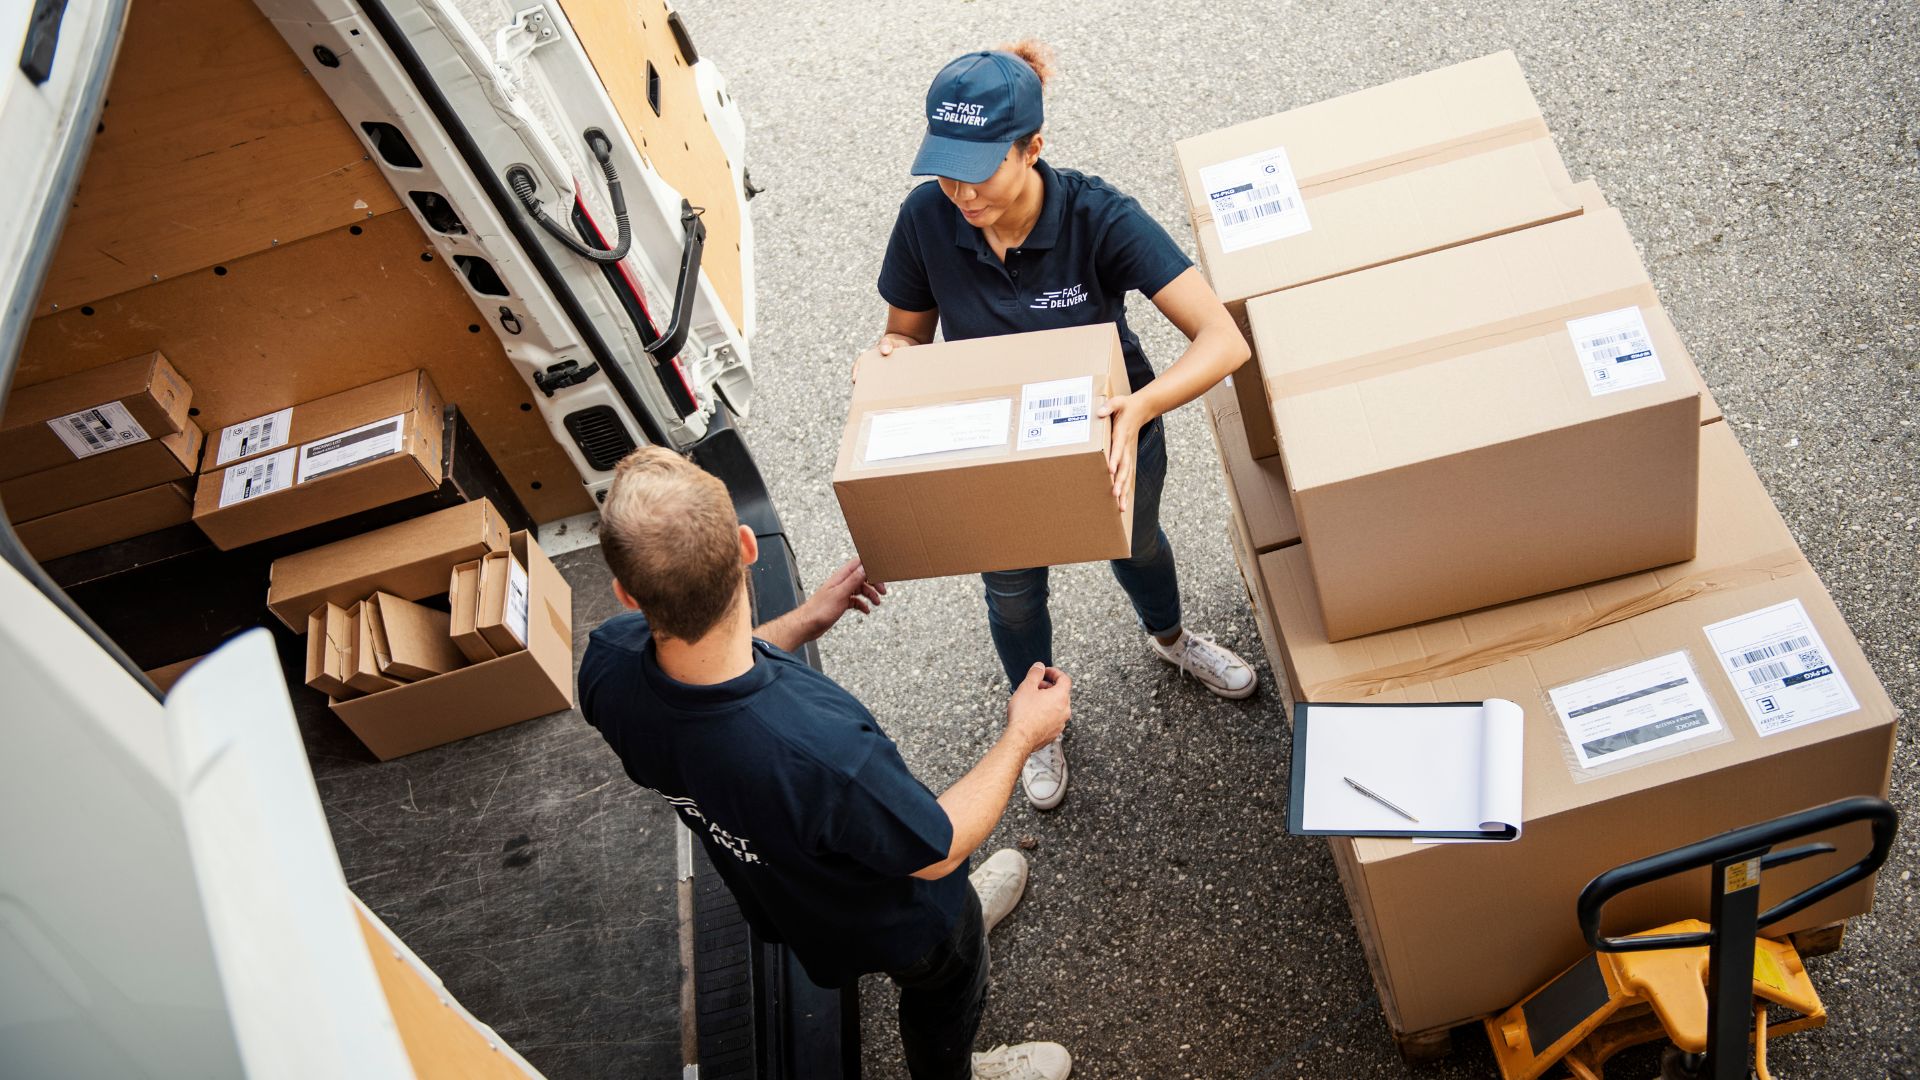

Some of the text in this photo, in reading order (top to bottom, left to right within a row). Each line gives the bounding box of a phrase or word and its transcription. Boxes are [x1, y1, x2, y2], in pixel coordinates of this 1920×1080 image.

[957, 102, 984, 116] FAST
[943, 111, 988, 127] DELIVERY
[1062, 283, 1082, 299] FAST
[1050, 292, 1088, 309] DELIVERY
[1803, 668, 1830, 680] W-PKG
[1761, 699, 1775, 711] E
